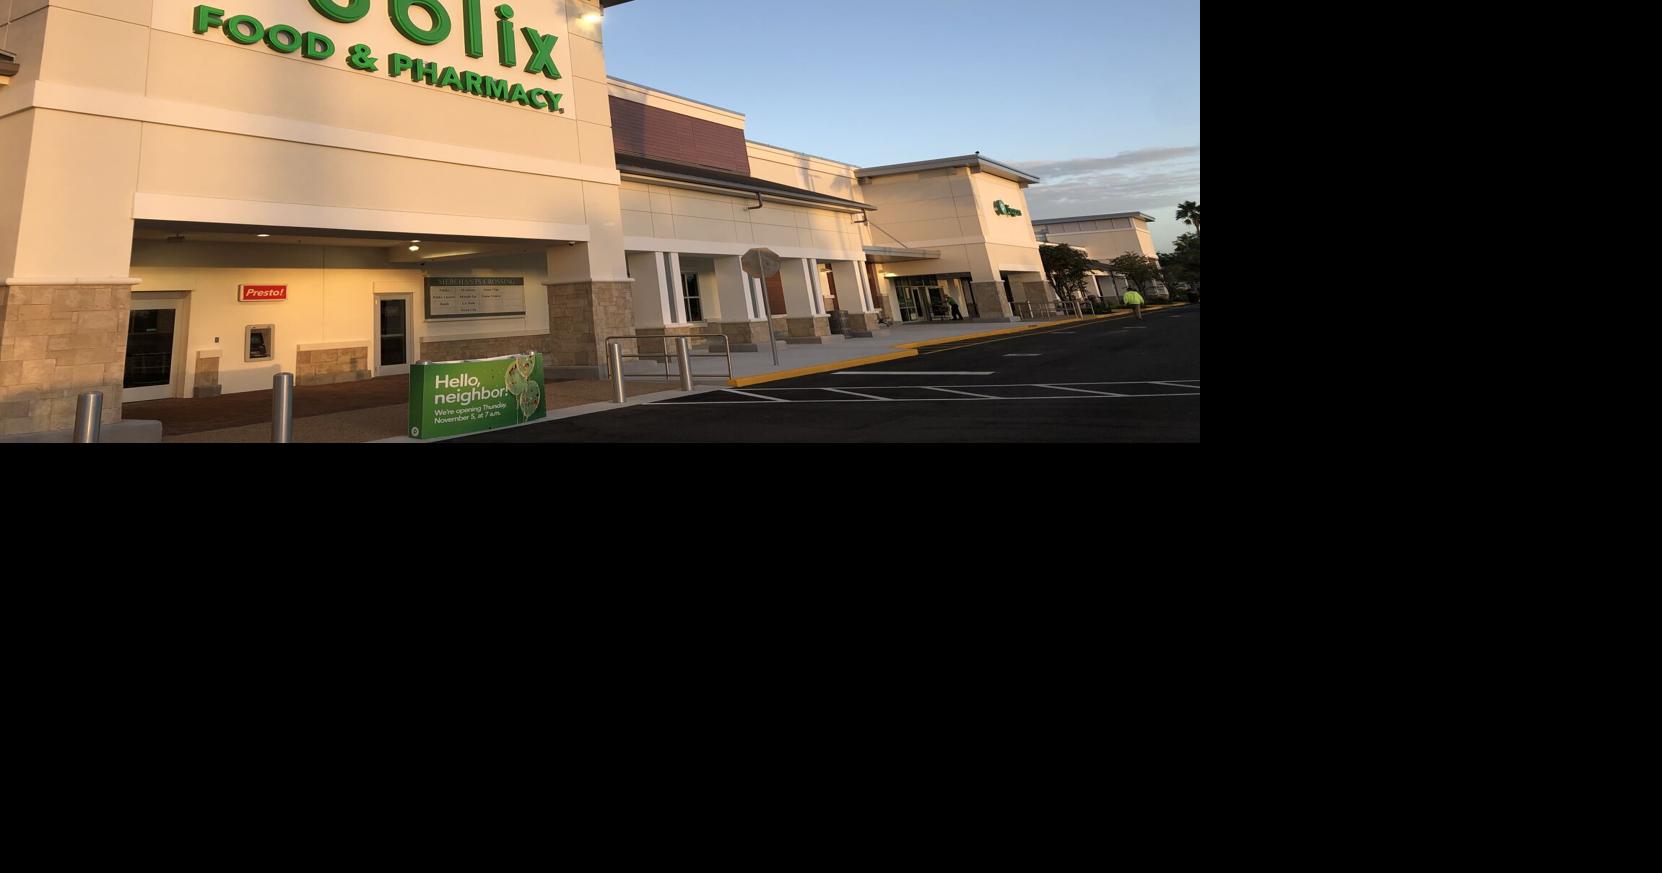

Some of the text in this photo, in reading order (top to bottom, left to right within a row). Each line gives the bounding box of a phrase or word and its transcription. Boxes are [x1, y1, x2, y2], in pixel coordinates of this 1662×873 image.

[193, 4, 336, 60] FOOD
[346, 43, 379, 72] &
[307, 0, 562, 80] blix
[245, 288, 285, 297] Presto!
[435, 373, 480, 389] Hello,
[434, 386, 508, 405] neighbor!
[456, 406, 481, 414] opening
[434, 415, 469, 424] November
